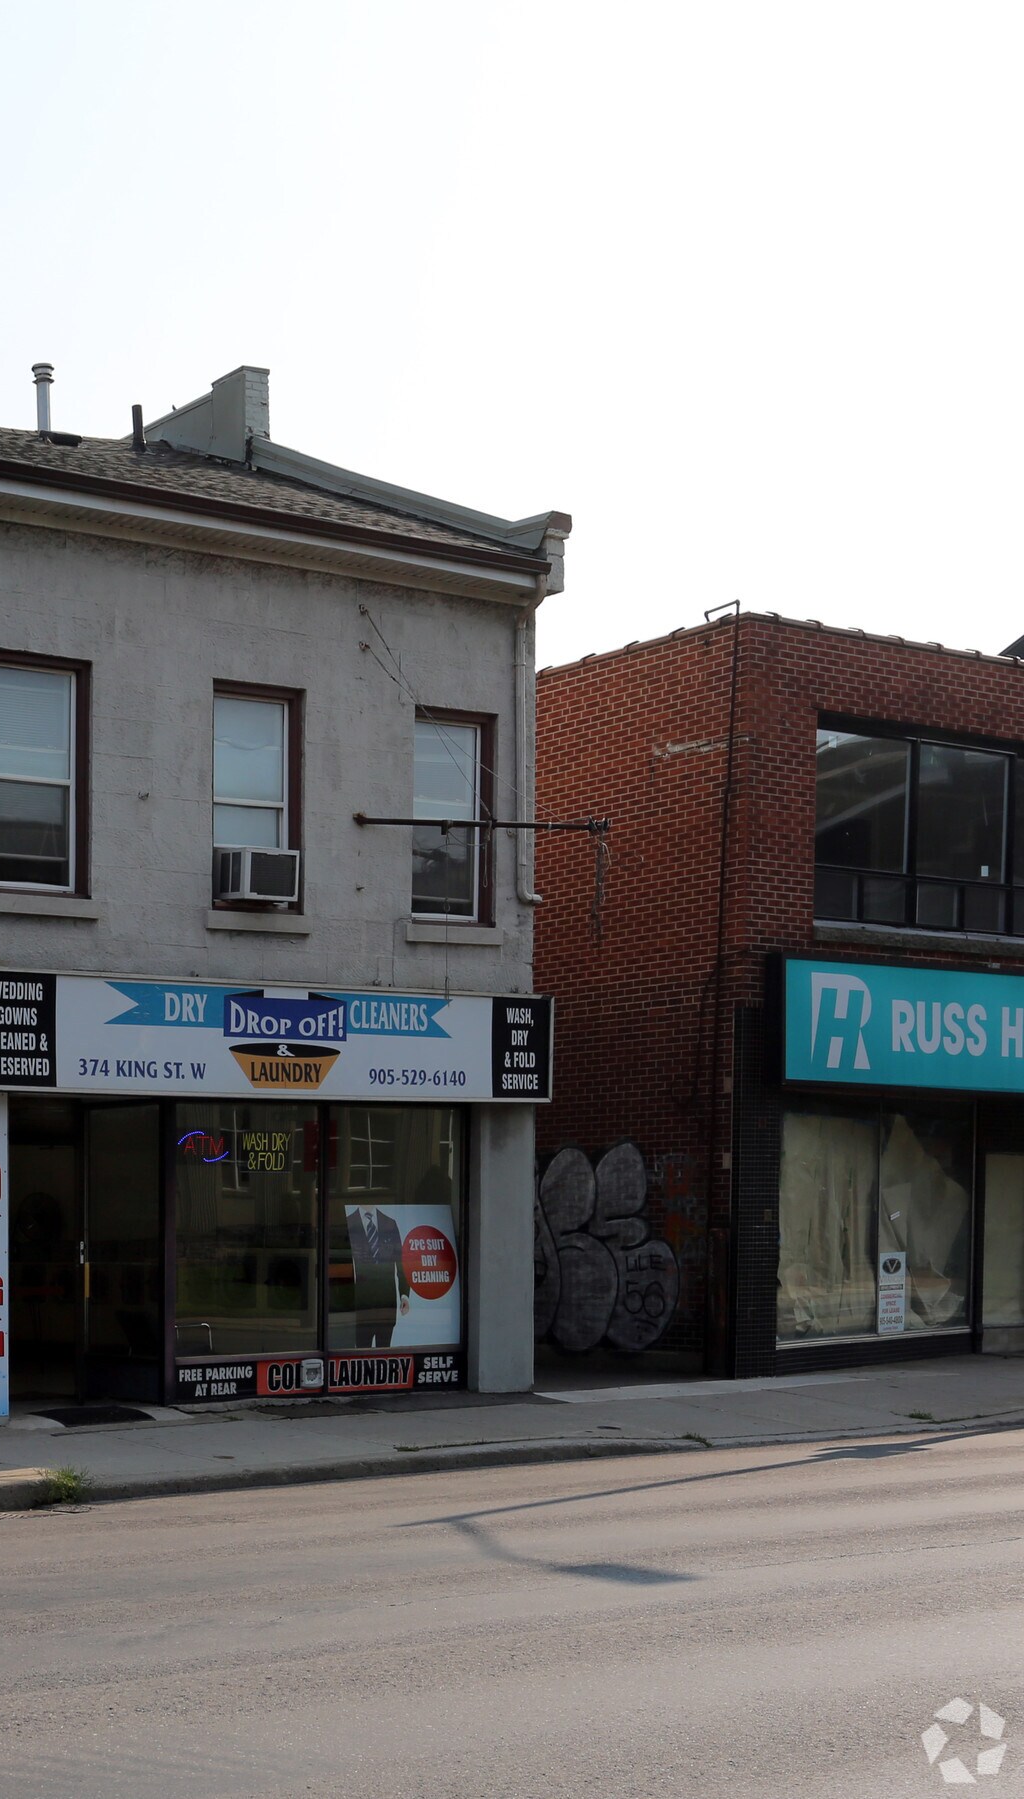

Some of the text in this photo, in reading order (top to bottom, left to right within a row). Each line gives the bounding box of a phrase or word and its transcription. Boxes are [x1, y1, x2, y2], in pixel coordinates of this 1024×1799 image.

[164, 992, 429, 1032] DRY CLEANERS
[506, 1007, 534, 1027] WASH,
[298, 1005, 344, 1038] OFF!
[891, 999, 987, 1057] RUSS
[39, 1034, 48, 1051] &
[511, 1030, 529, 1046] DRY
[276, 1044, 296, 1057] &
[78, 1058, 206, 1080] 374 KING ST. W
[504, 1052, 535, 1068] & FOLD
[250, 1061, 322, 1083] LAUNDRY
[369, 1068, 466, 1087] 905-529-6140
[502, 1073, 538, 1090] SERVICE
[183, 1135, 225, 1156] ATM
[241, 1132, 291, 1151] WASH DRY
[247, 1152, 285, 1171] & FOLD
[408, 1238, 445, 1251] 2PC SUIT
[420, 1254, 438, 1268] DRY
[411, 1270, 450, 1284] CLEANING
[423, 1356, 454, 1369] SELF
[178, 1365, 253, 1383] FREE PARKING
[328, 1357, 412, 1387] LAUNDRY
[417, 1370, 458, 1384] SERVE
[195, 1381, 237, 1397] AT REAR
